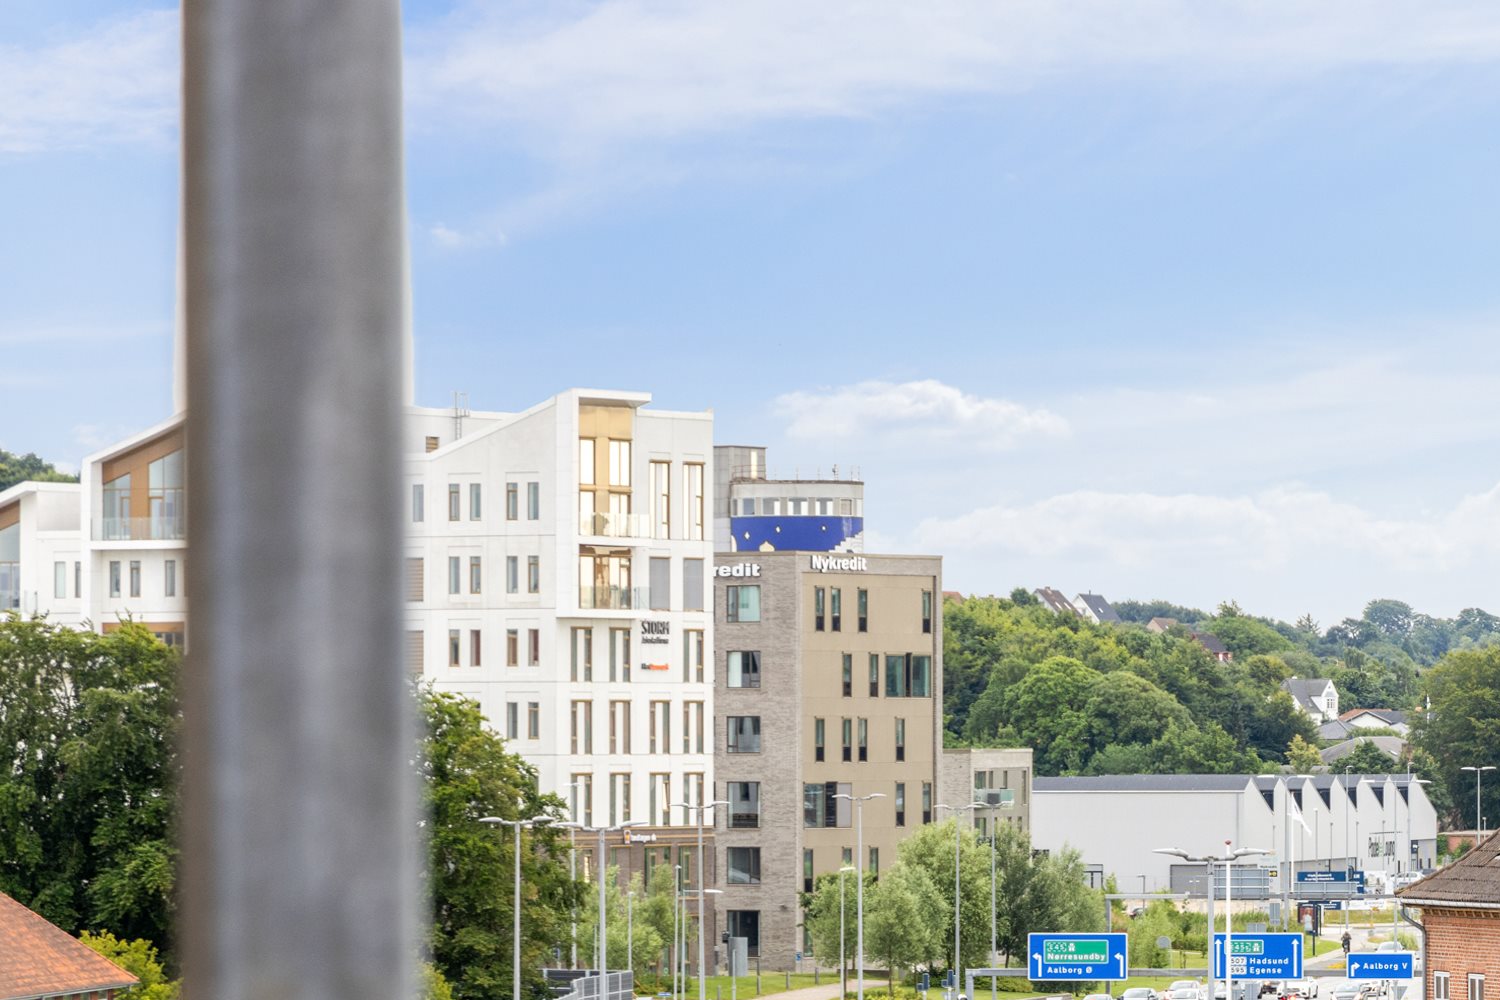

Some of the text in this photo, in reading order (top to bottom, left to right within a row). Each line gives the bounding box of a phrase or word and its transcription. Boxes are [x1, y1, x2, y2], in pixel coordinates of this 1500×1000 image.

[810, 555, 867, 573] Nykredit
[1047, 953, 1105, 961] Nørresundby
[1047, 966, 1093, 975] Aalborg Ø
[1249, 967, 1282, 975] Egense
[1363, 962, 1399, 971] Aalborg
